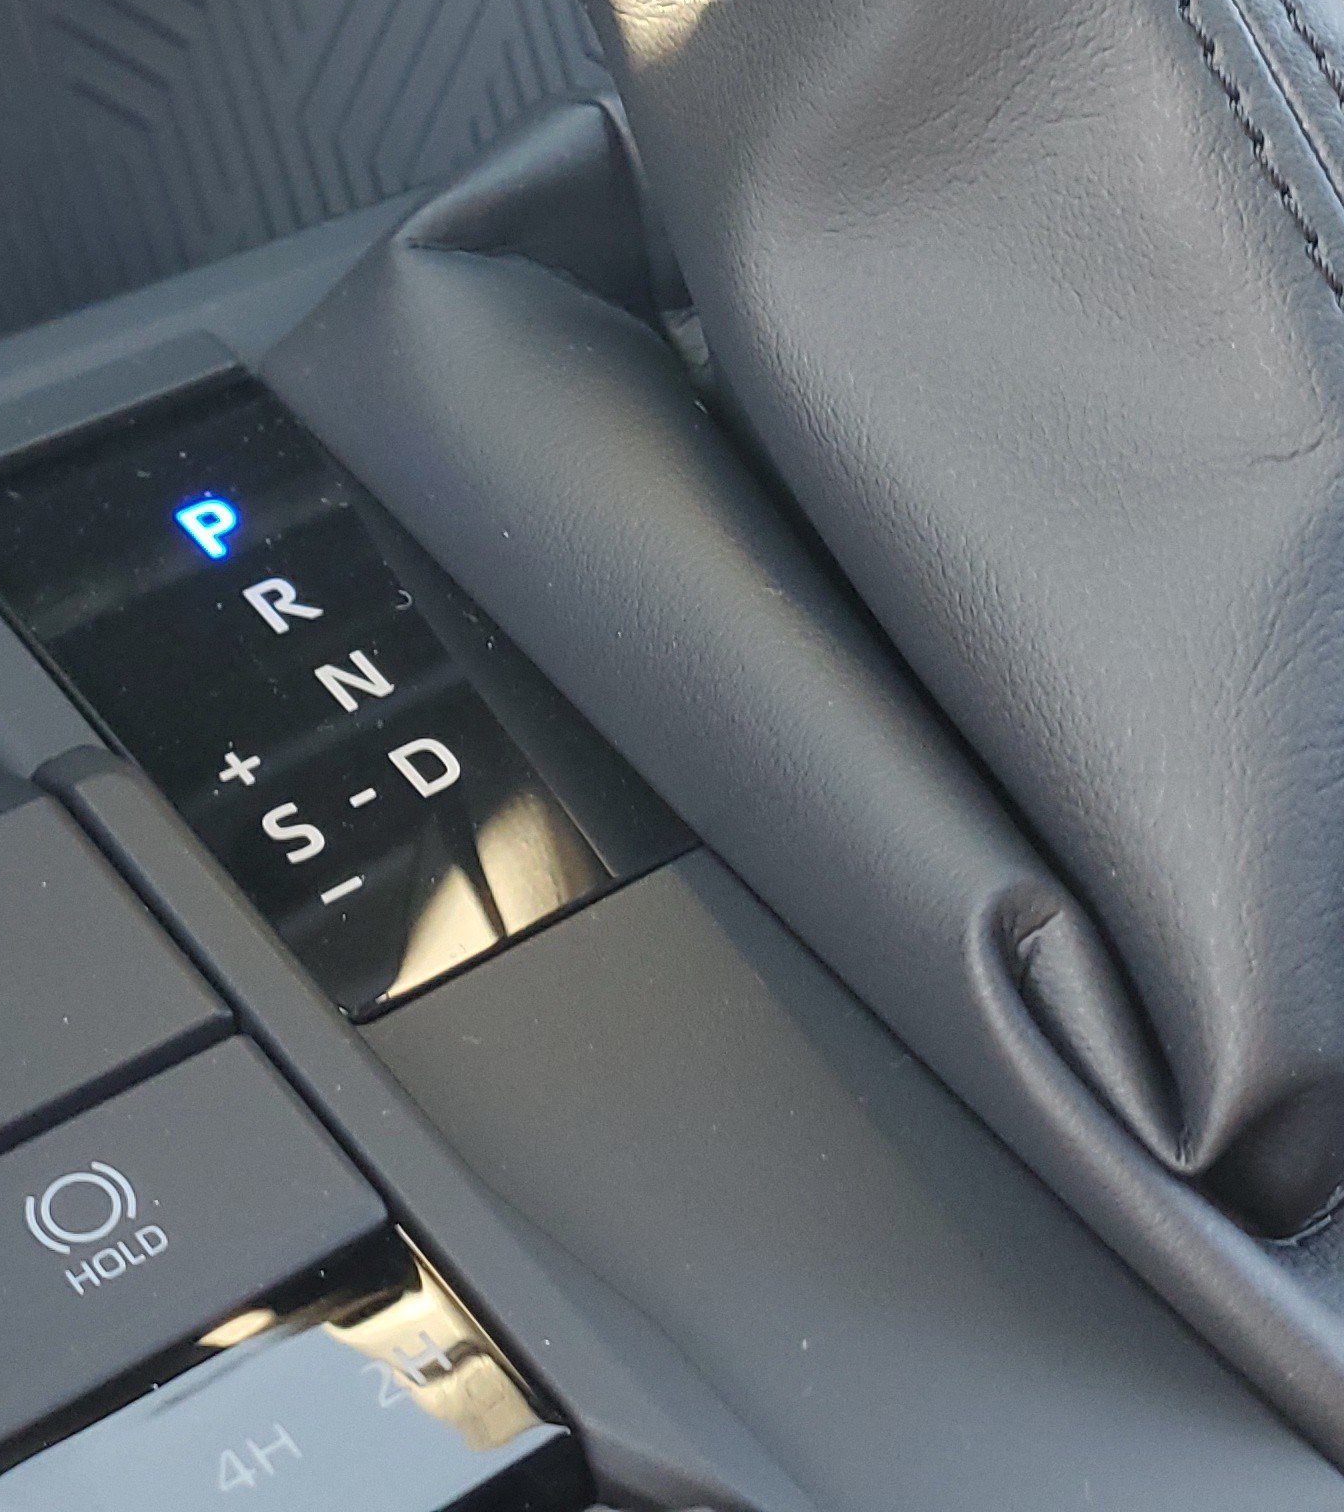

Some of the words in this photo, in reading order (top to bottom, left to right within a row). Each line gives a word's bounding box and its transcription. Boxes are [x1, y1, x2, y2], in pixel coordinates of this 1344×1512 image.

[175, 499, 239, 559] P
[243, 578, 323, 633] R
[315, 650, 394, 712] N
[388, 738, 461, 798] D
[262, 802, 325, 863] S
[65, 1225, 169, 1295] HOLD
[360, 1329, 452, 1408] 2H
[220, 1421, 303, 1490] 4H
